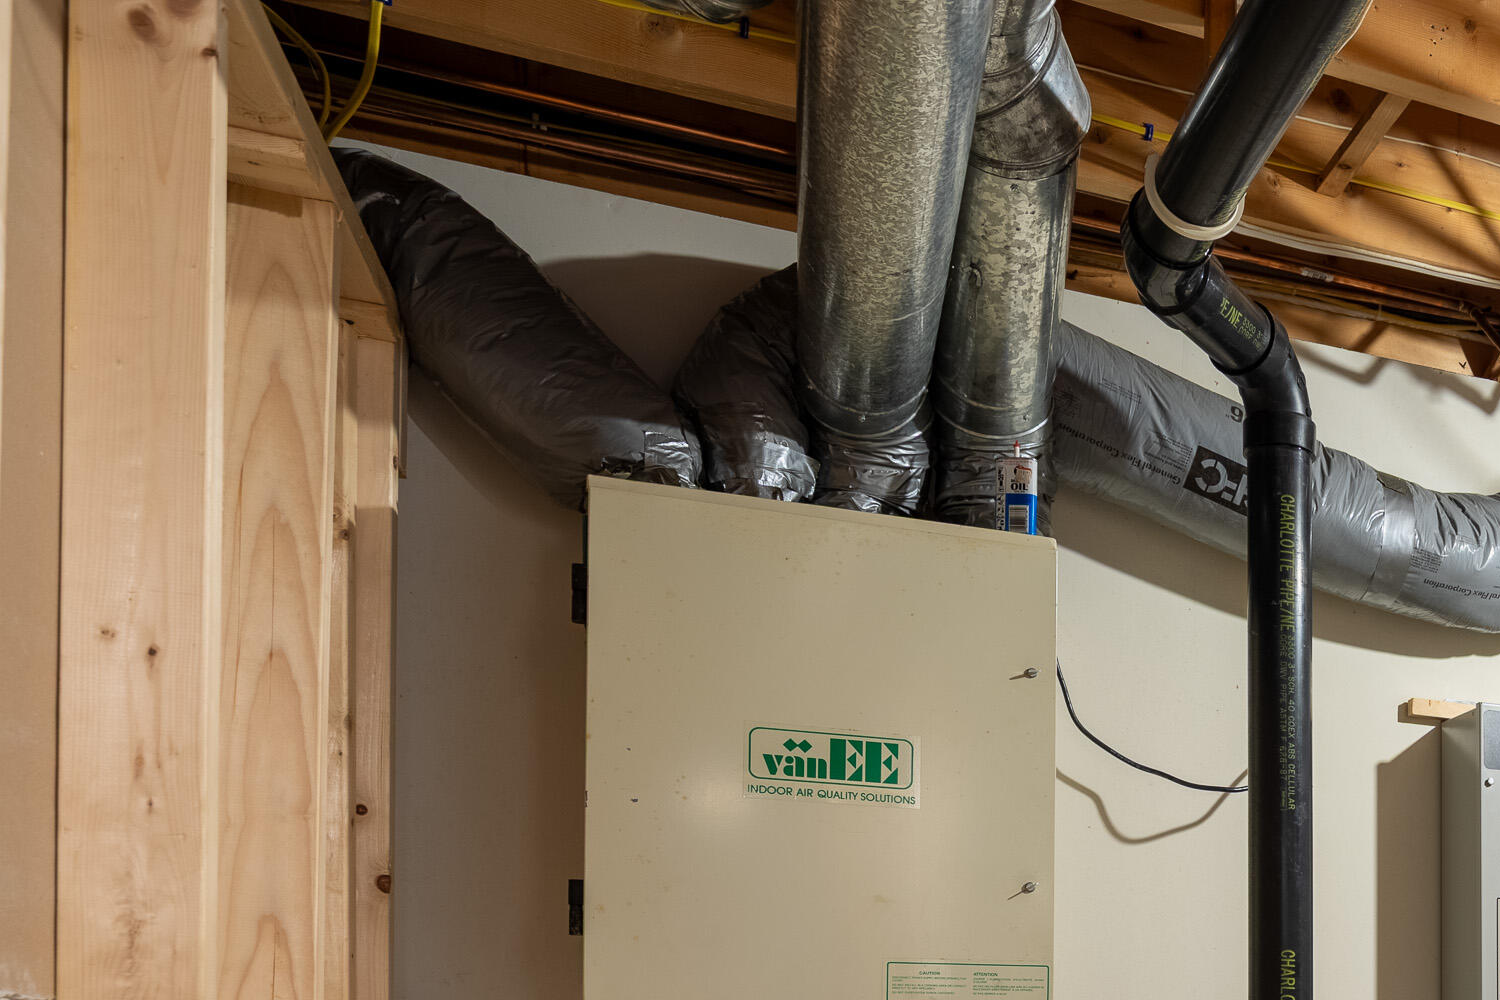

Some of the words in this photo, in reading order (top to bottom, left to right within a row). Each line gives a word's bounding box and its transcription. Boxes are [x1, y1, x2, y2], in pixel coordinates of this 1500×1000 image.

[1010, 482, 1028, 491] OIL
[1280, 493, 1296, 573] CHARLOTTE
[1423, 578, 1472, 596] Corporation
[1472, 589, 1492, 600] Flex
[1279, 579, 1296, 632] PIPE/NE
[1287, 715, 1296, 738] COEX
[1287, 742, 1296, 759] ABS
[747, 784, 793, 796] INDOOR
[796, 788, 813, 798] AIR
[817, 789, 859, 801] QUALITY
[860, 792, 916, 805] SOLUTIONS
[1287, 763, 1296, 810] CELLULAR
